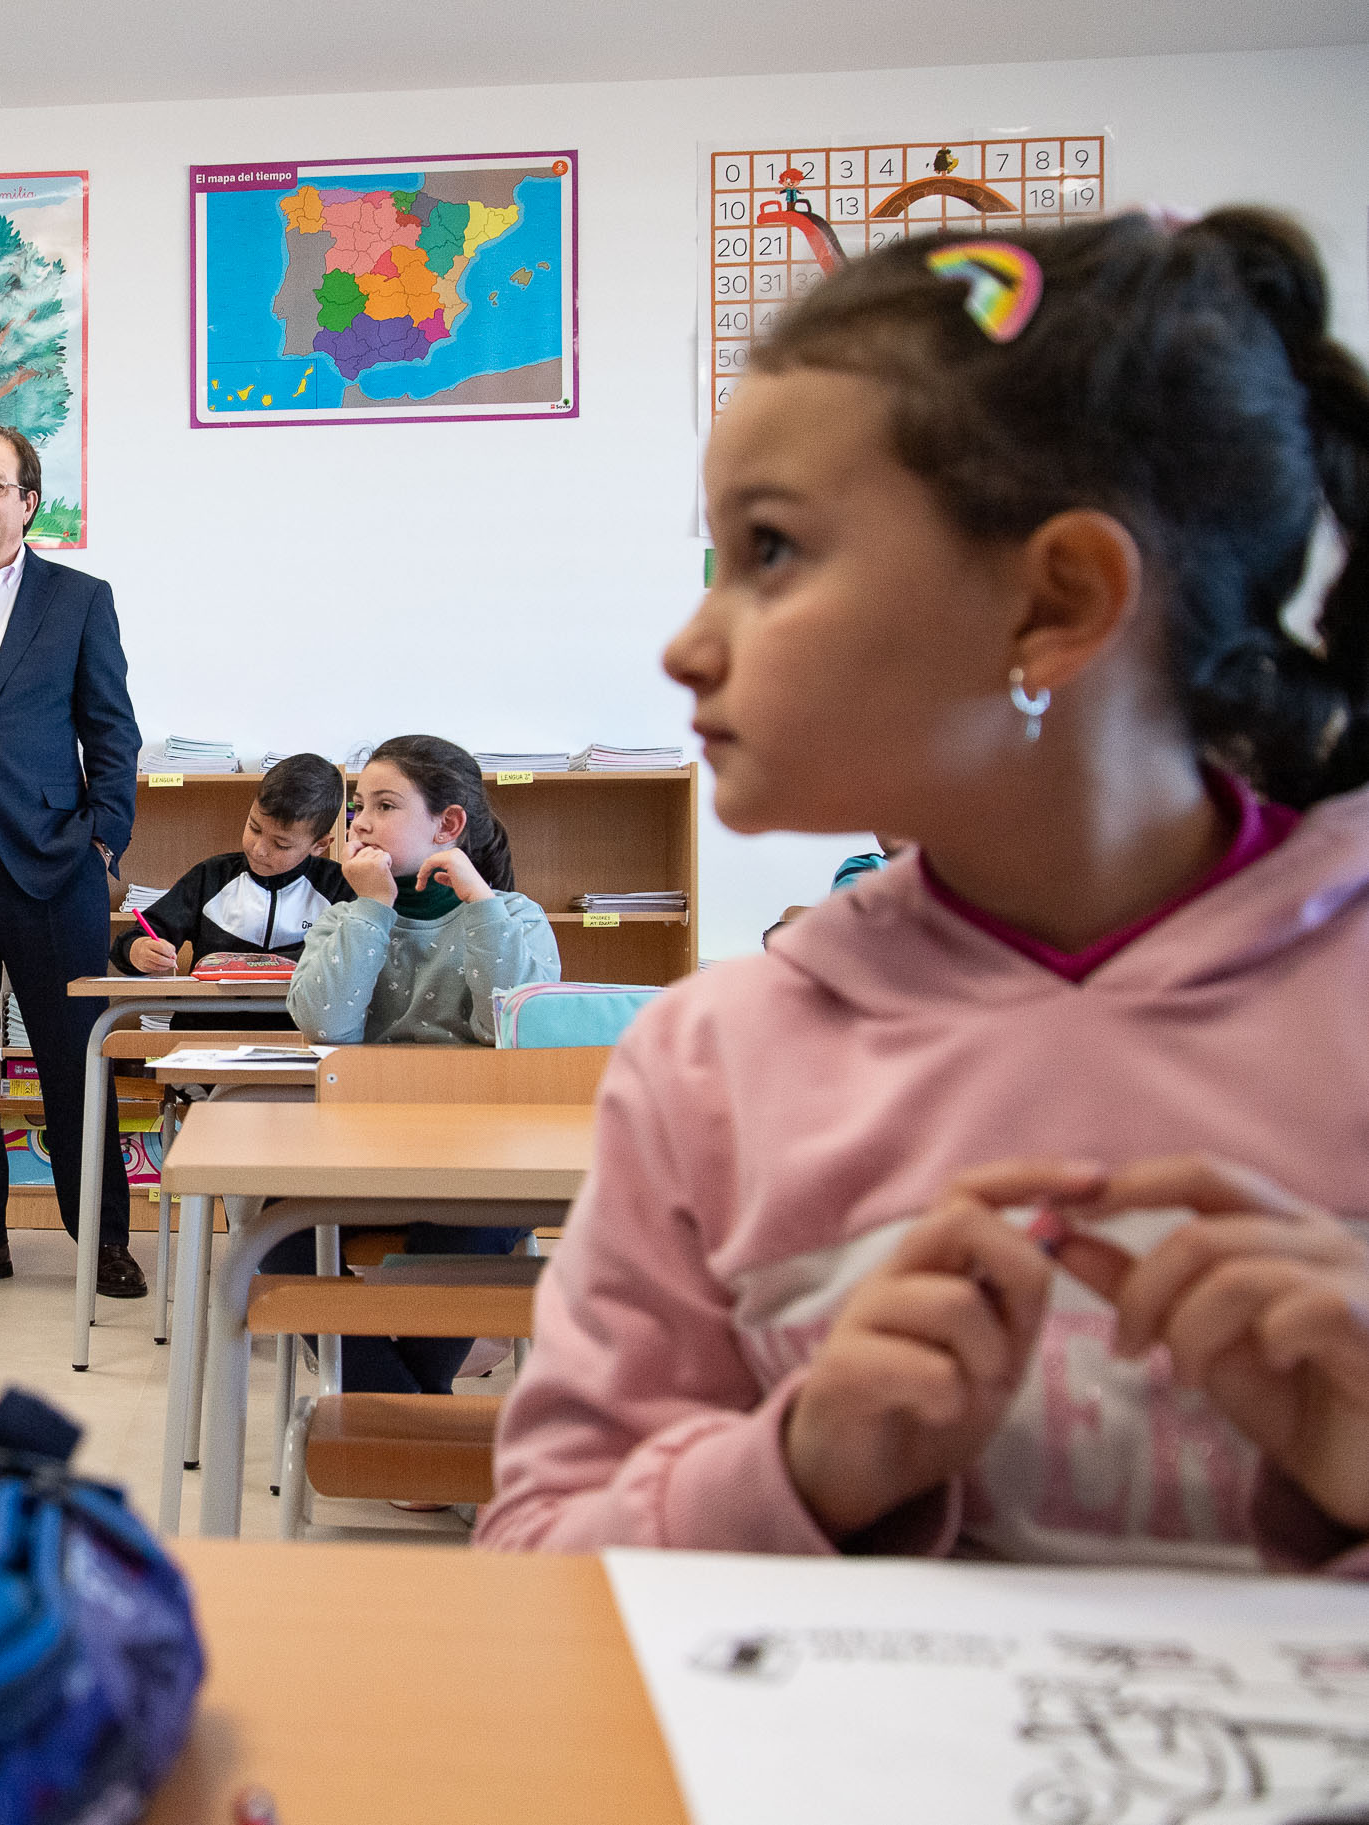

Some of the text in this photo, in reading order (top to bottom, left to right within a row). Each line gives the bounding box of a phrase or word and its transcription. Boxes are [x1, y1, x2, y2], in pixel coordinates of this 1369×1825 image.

[725, 149, 1089, 183] 0 1 2 3 4 7 8 9
[196, 171, 292, 185] El mapa del tiempo
[719, 187, 1094, 220] 10 13 18 19
[717, 231, 901, 257] 20 21 24
[717, 275, 748, 294] 30
[759, 274, 781, 293] 31
[717, 312, 748, 331] 40
[718, 348, 748, 368] 50
[500, 774, 523, 782] LENGUA
